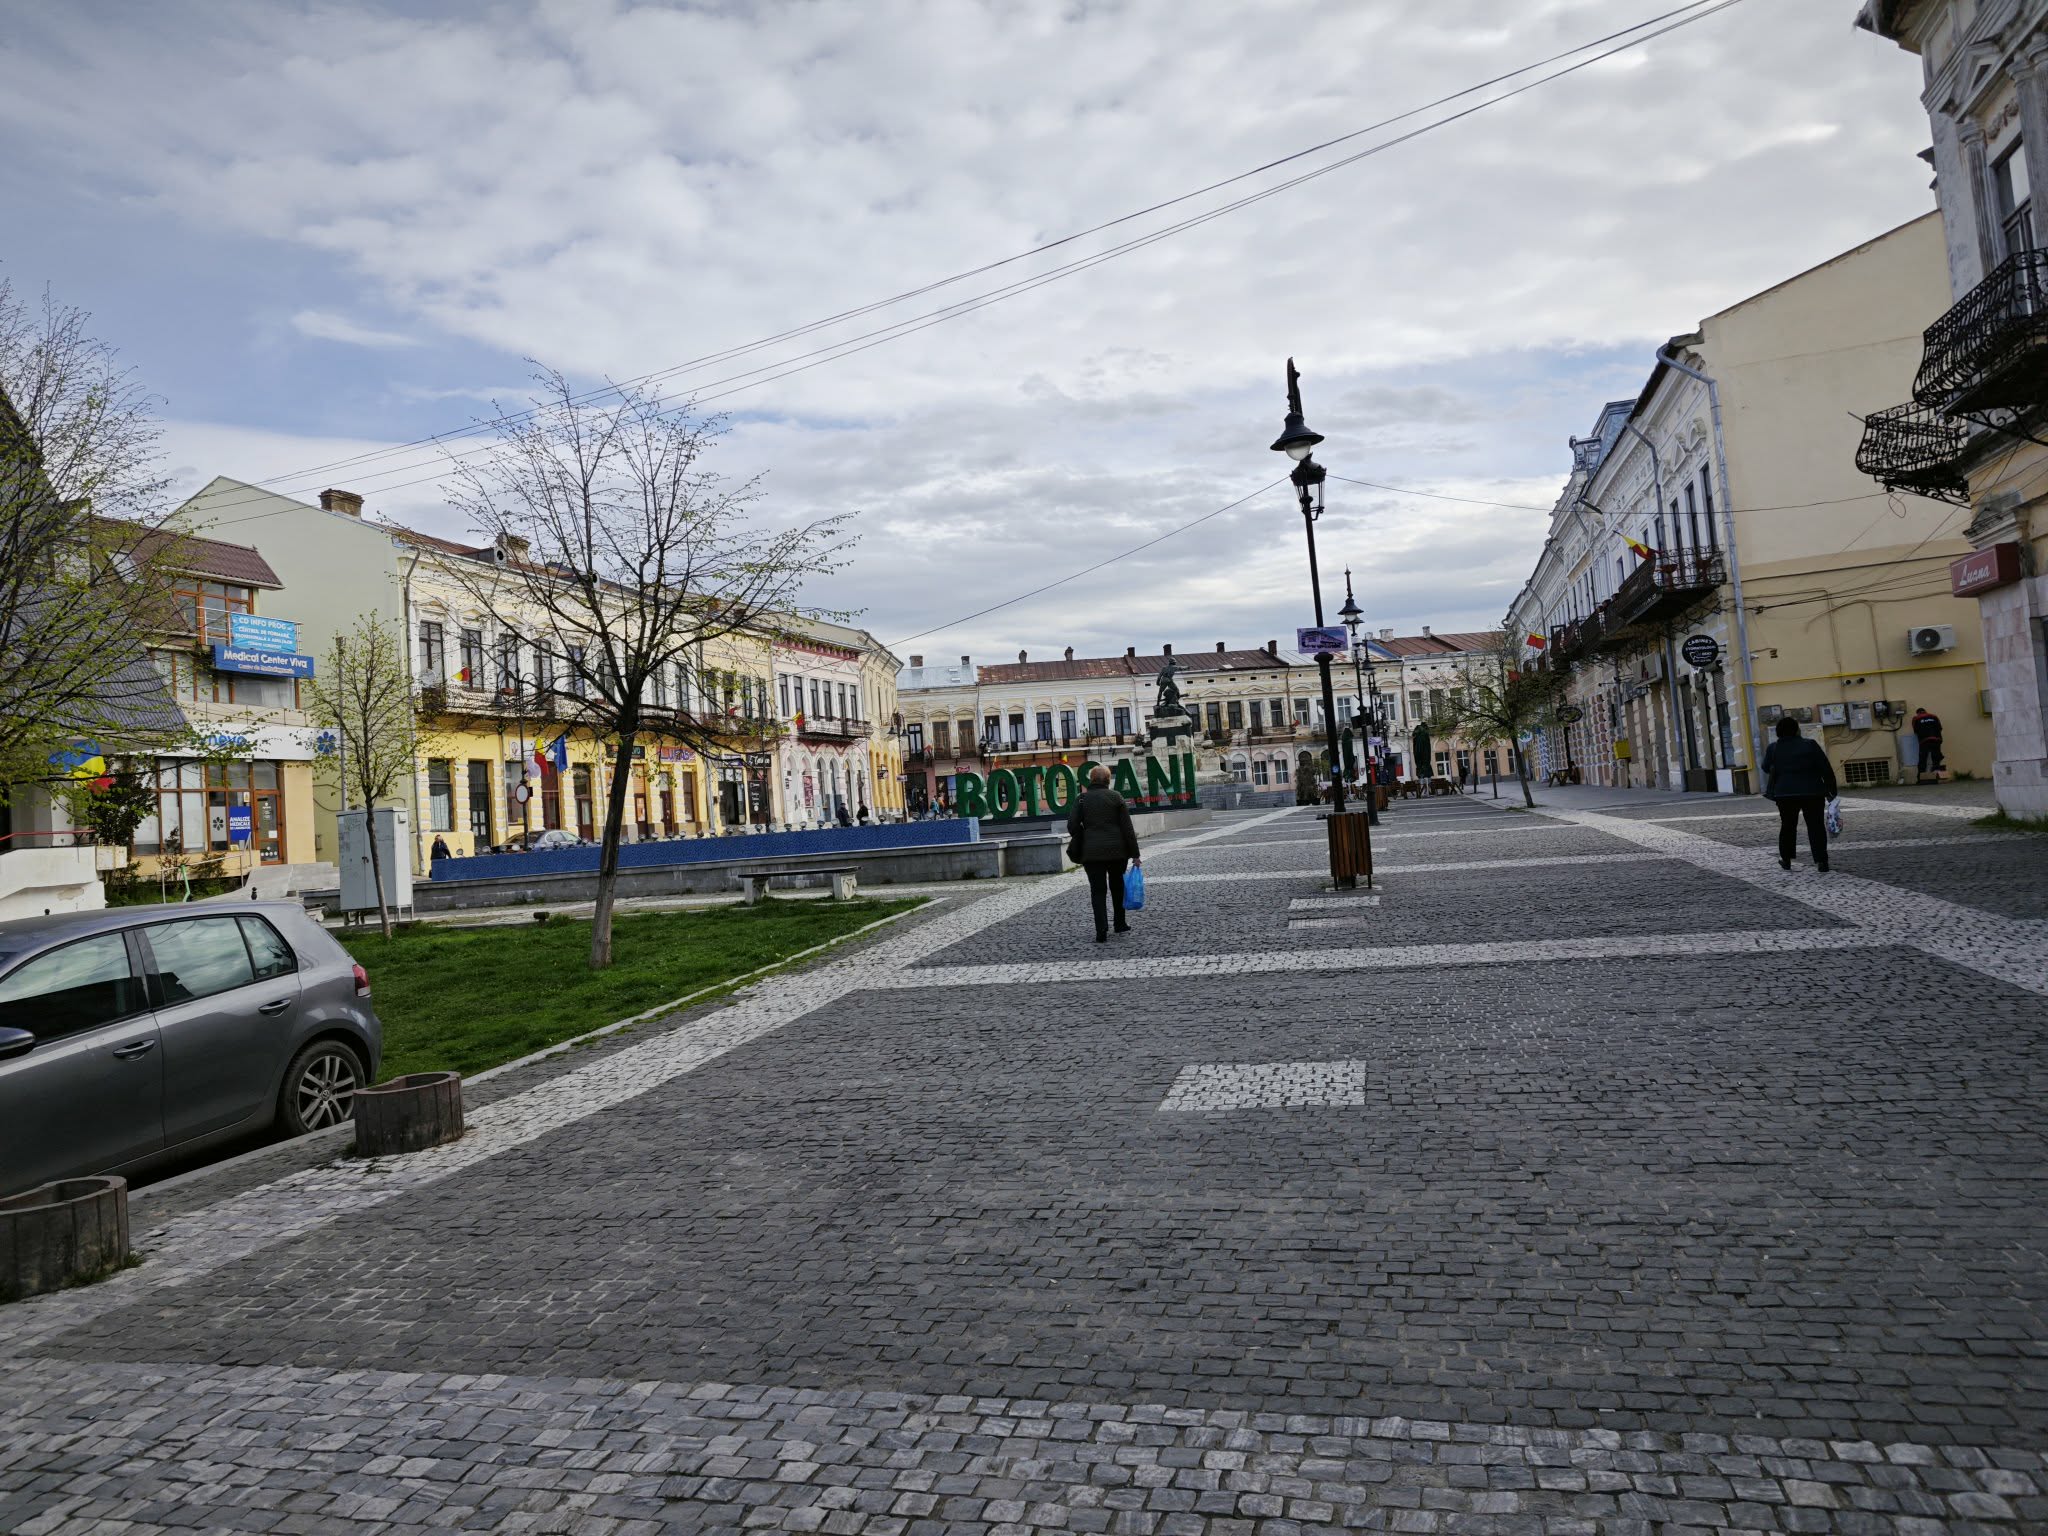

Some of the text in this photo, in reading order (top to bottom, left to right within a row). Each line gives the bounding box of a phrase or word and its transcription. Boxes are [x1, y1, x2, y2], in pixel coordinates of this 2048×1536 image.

[250, 618, 267, 627] INFO
[268, 620, 287, 630] PROG
[223, 649, 259, 663] Medical
[260, 654, 289, 666] Center
[289, 657, 308, 669] Viva
